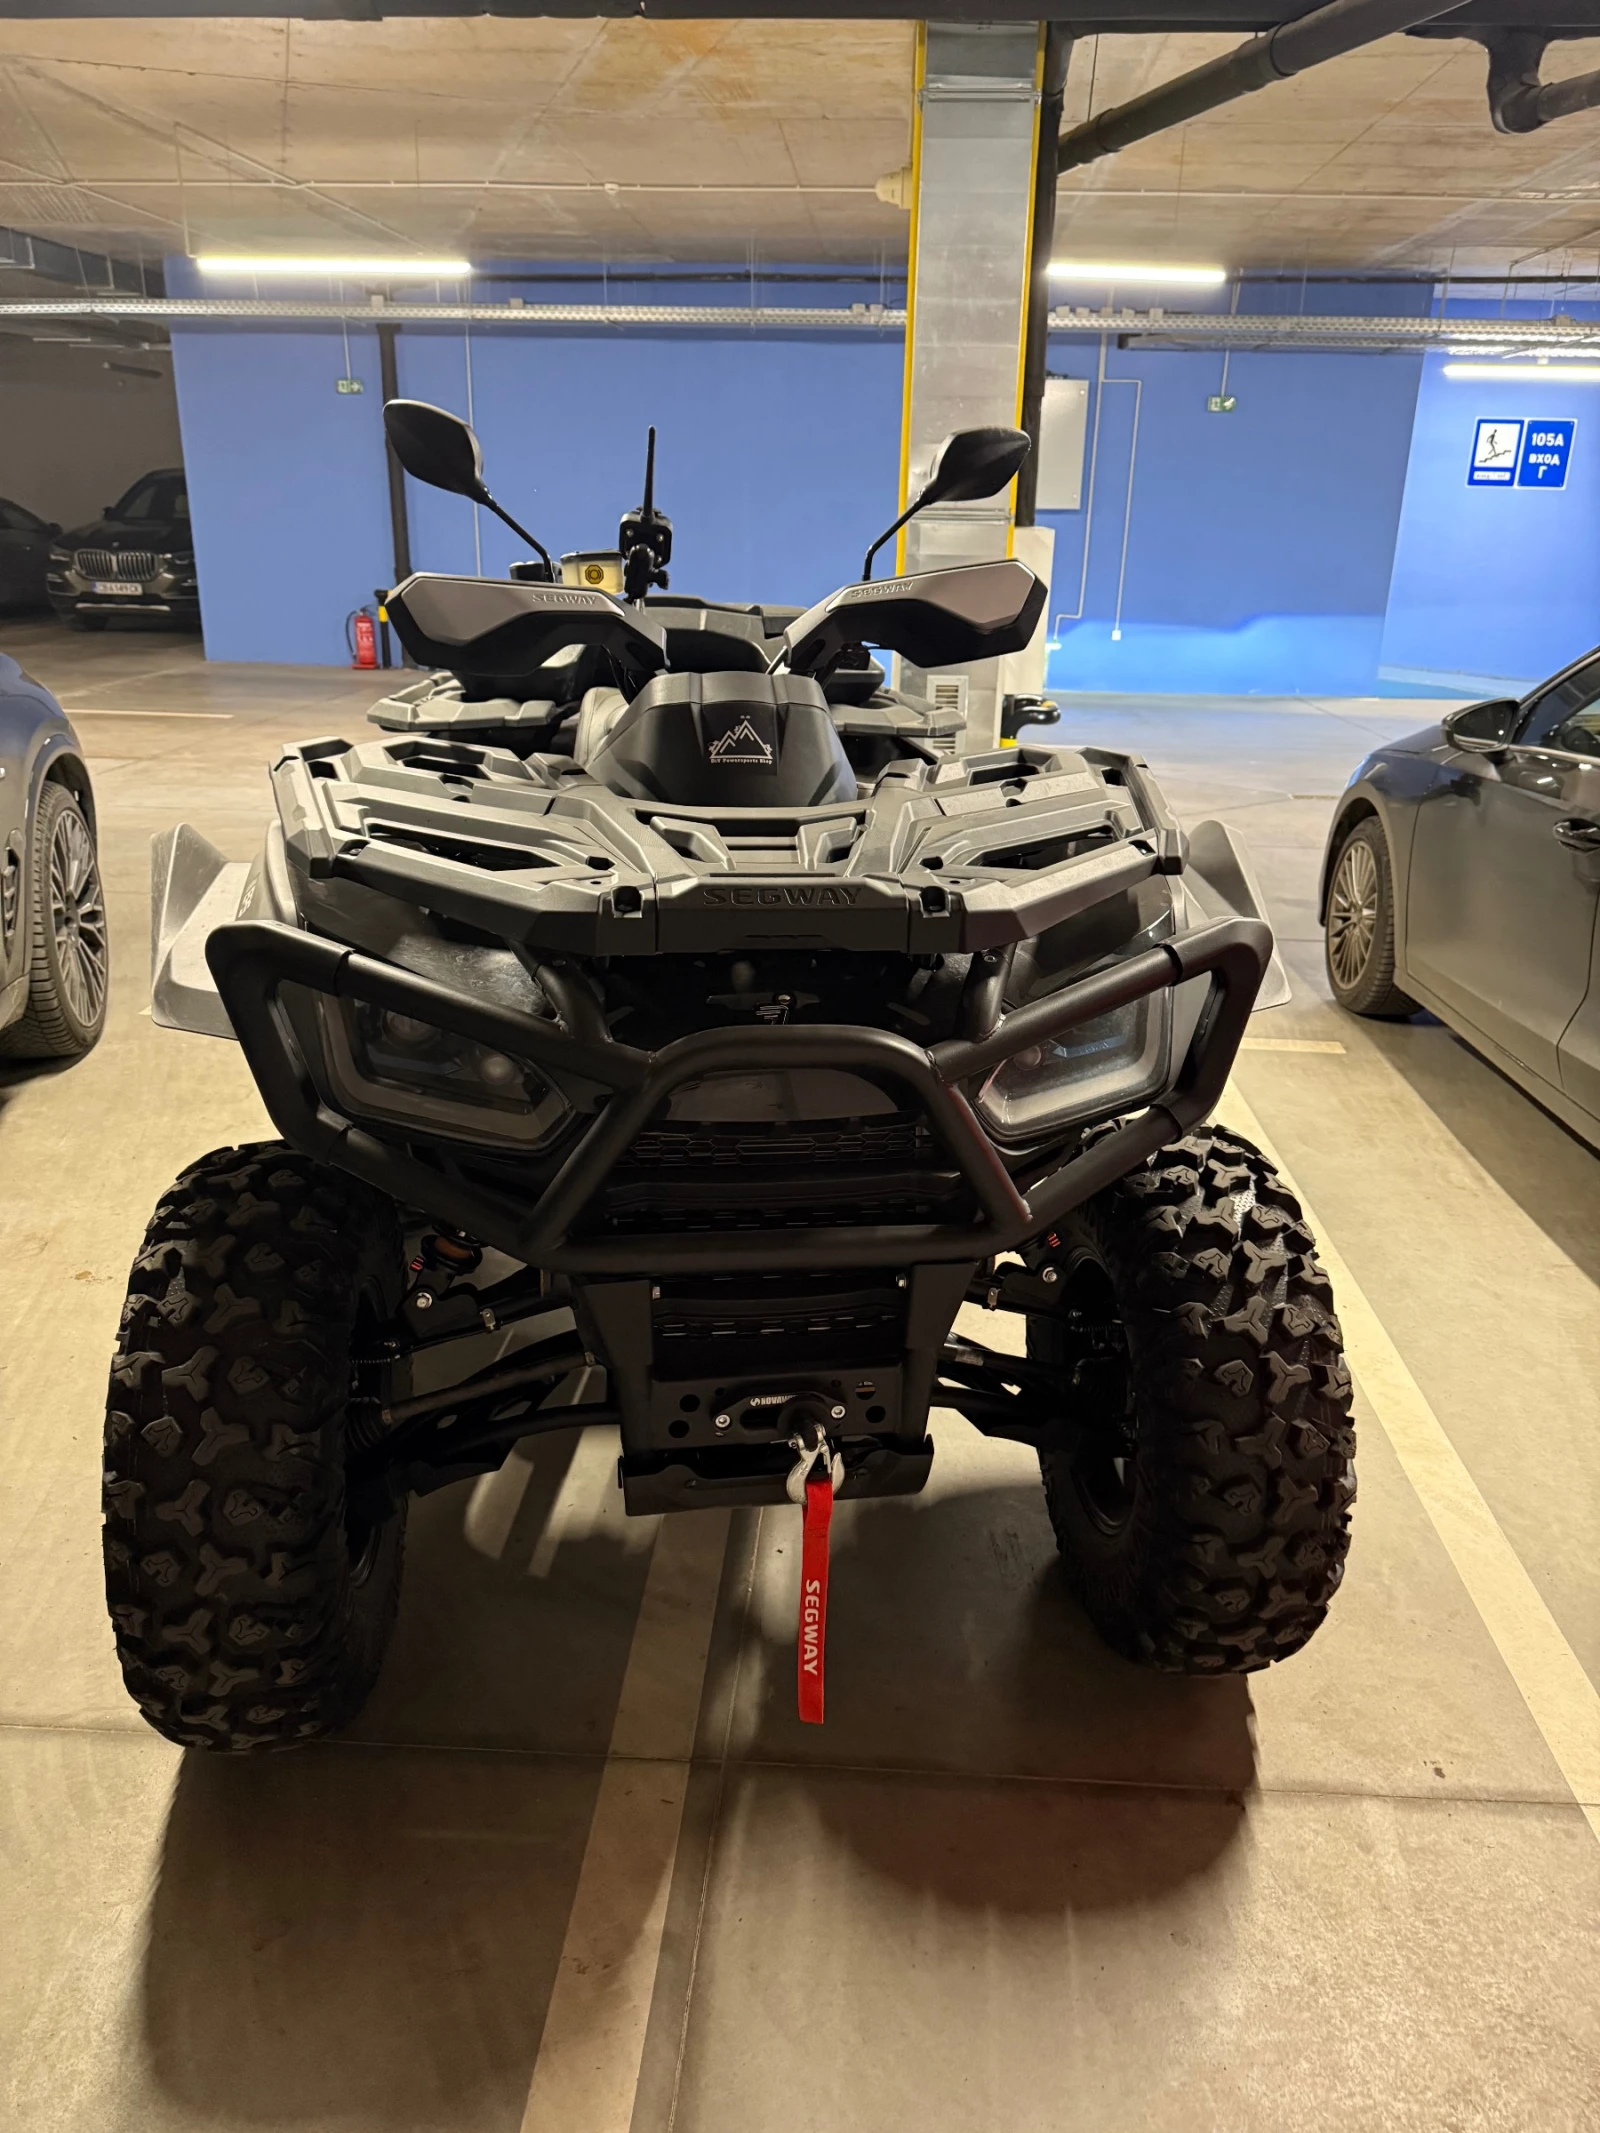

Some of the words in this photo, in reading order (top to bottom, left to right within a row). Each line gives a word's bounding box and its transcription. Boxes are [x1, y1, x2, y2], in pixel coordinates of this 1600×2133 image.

[1538, 466, 1548, 479] Г
[851, 581, 914, 598] SEGWAY
[532, 593, 597, 605] SEGWAY
[703, 887, 862, 906] SEGWAY
[804, 1579, 820, 1677] SEGWAY
